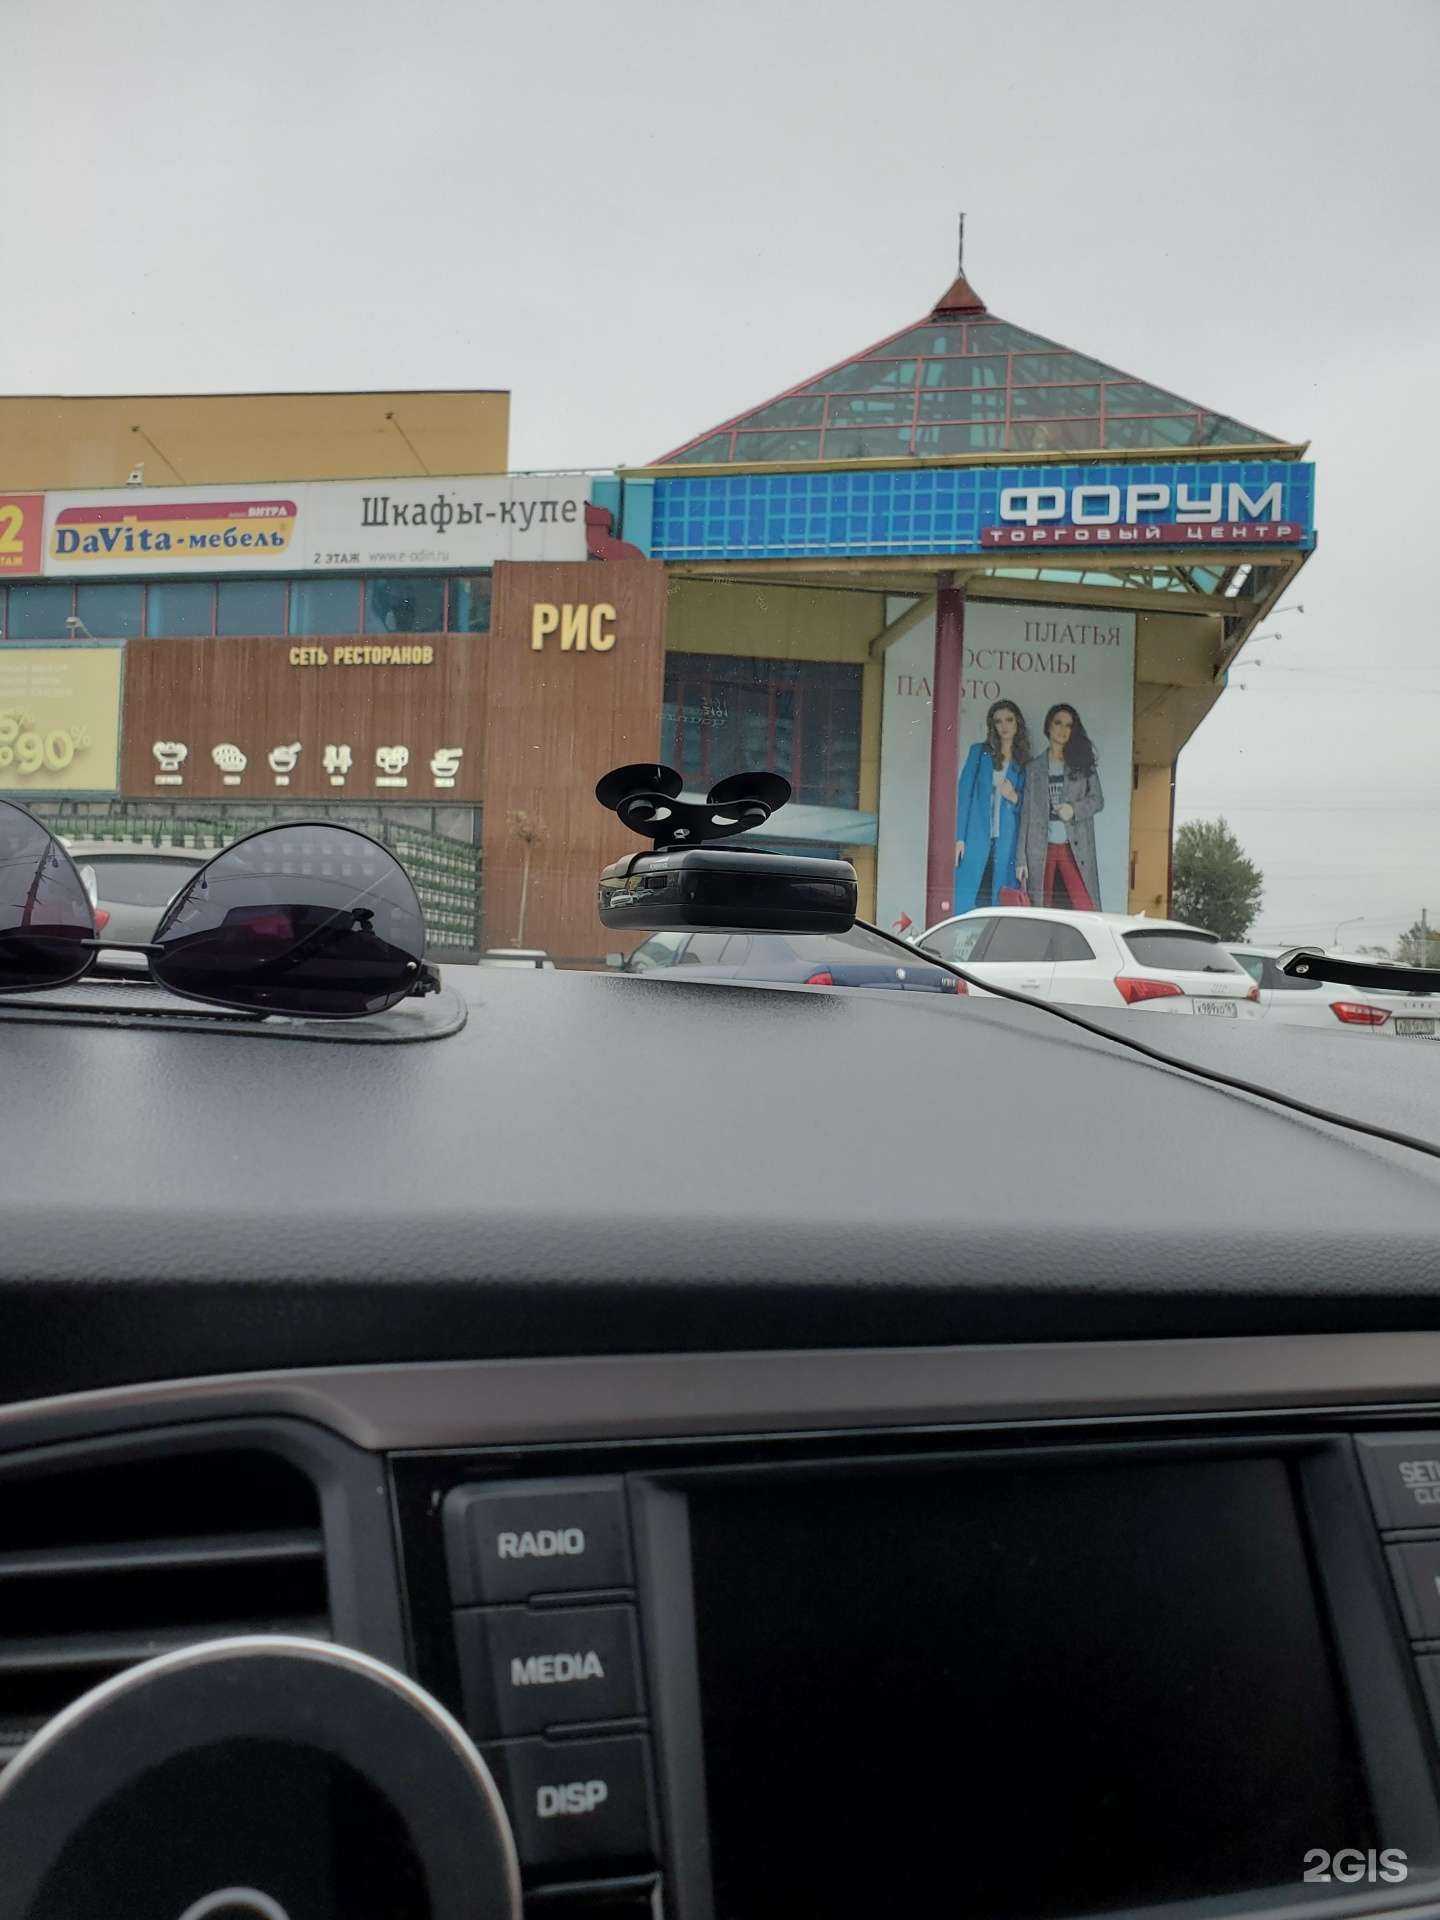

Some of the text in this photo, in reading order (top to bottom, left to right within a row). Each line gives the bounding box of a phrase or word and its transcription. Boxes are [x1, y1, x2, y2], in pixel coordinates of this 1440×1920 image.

[361, 494, 577, 534] Шкафы-купе
[1000, 482, 1282, 526] ФОРУМ
[0, 504, 24, 553] 2
[990, 525, 1293, 543] ТОРГОВЫЙ ЦЕНТР
[314, 553, 321, 564] 2
[325, 552, 360, 564] ЭТАЖ
[531, 603, 617, 652] РИС
[1025, 621, 1121, 646] ПЛАТЬЯ
[289, 646, 434, 666] СЕТЬ РЕСТОРАНОВ
[497, 1528, 585, 1560] RADIO
[510, 1650, 604, 1686] MEDIA
[536, 1780, 609, 1819] DISP
